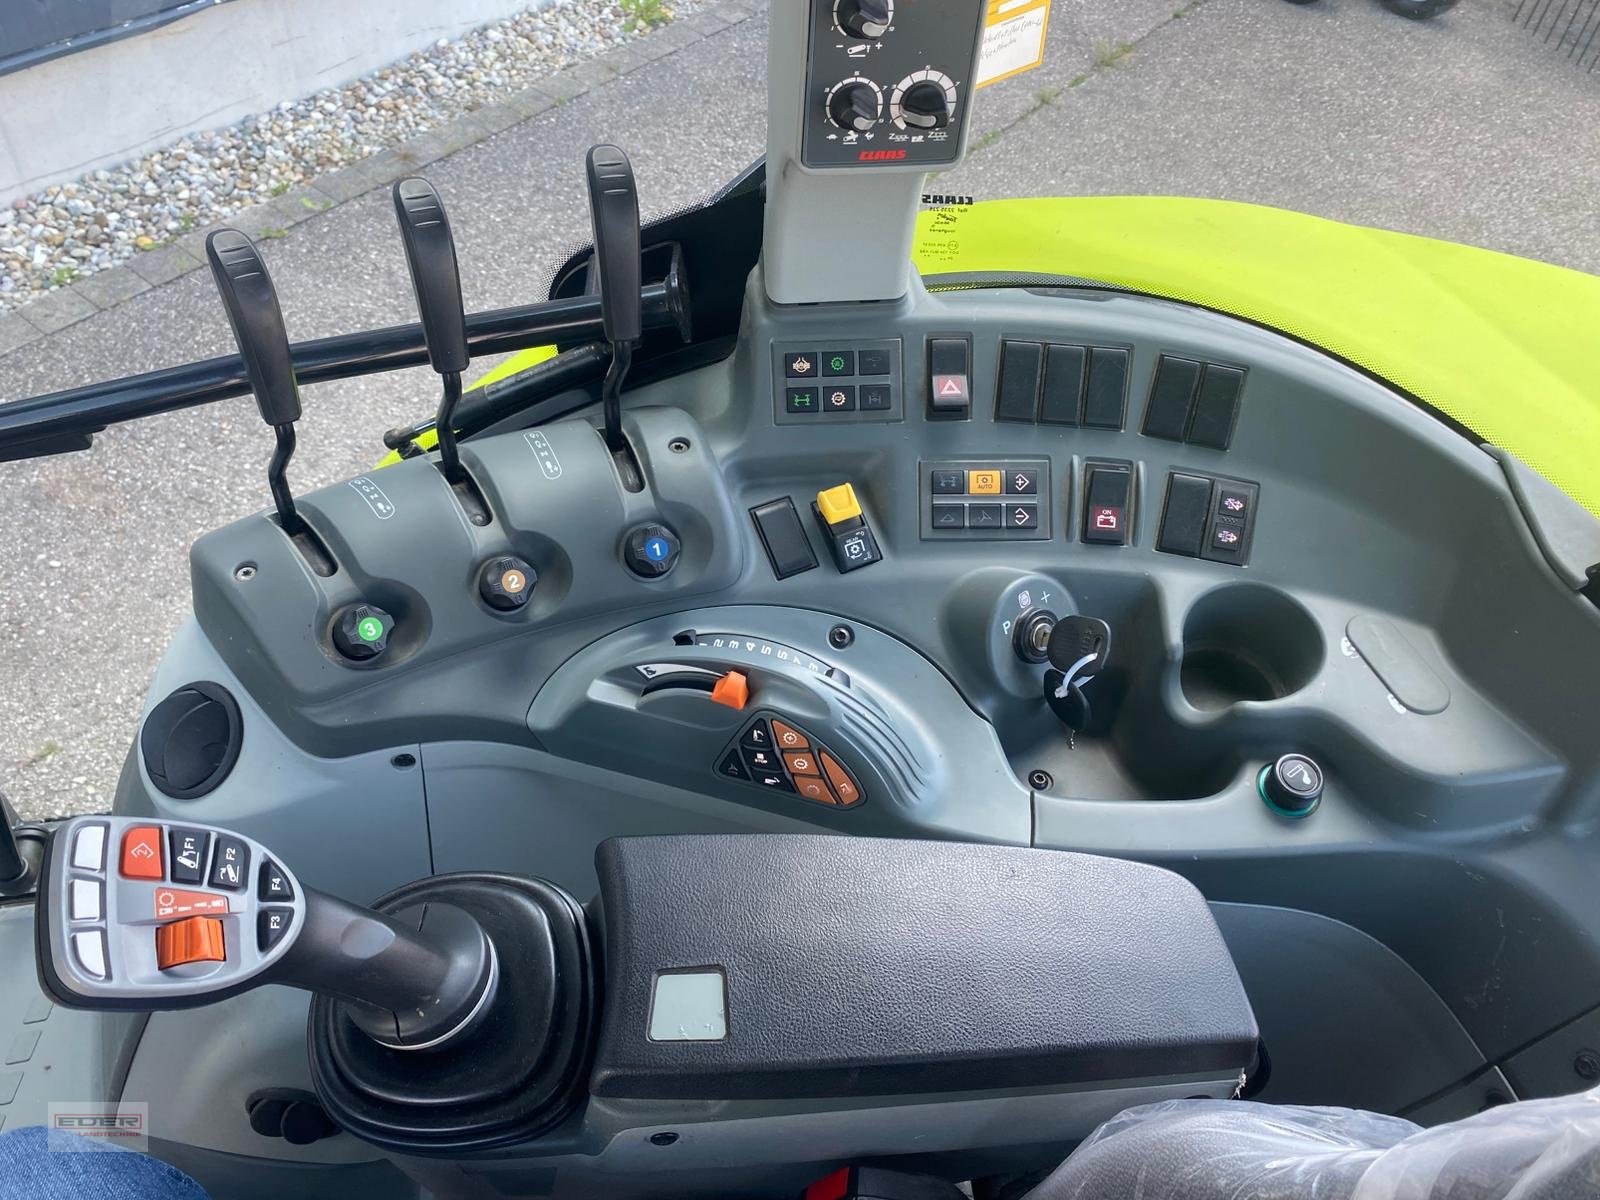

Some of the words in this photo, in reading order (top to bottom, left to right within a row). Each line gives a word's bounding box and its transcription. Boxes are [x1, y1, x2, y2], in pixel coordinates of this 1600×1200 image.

[859, 150, 906, 161] CLAAS
[652, 543, 661, 556] 1
[508, 574, 520, 589] 2
[364, 622, 377, 637] 3
[1002, 620, 1010, 634] P
[713, 639, 724, 648] 2
[728, 640, 739, 649] 3
[745, 641, 756, 651] 4
[760, 645, 772, 655] 5
[184, 837, 195, 850] F1
[226, 847, 236, 860] F2
[271, 877, 281, 891] F4
[270, 915, 280, 929] F3
